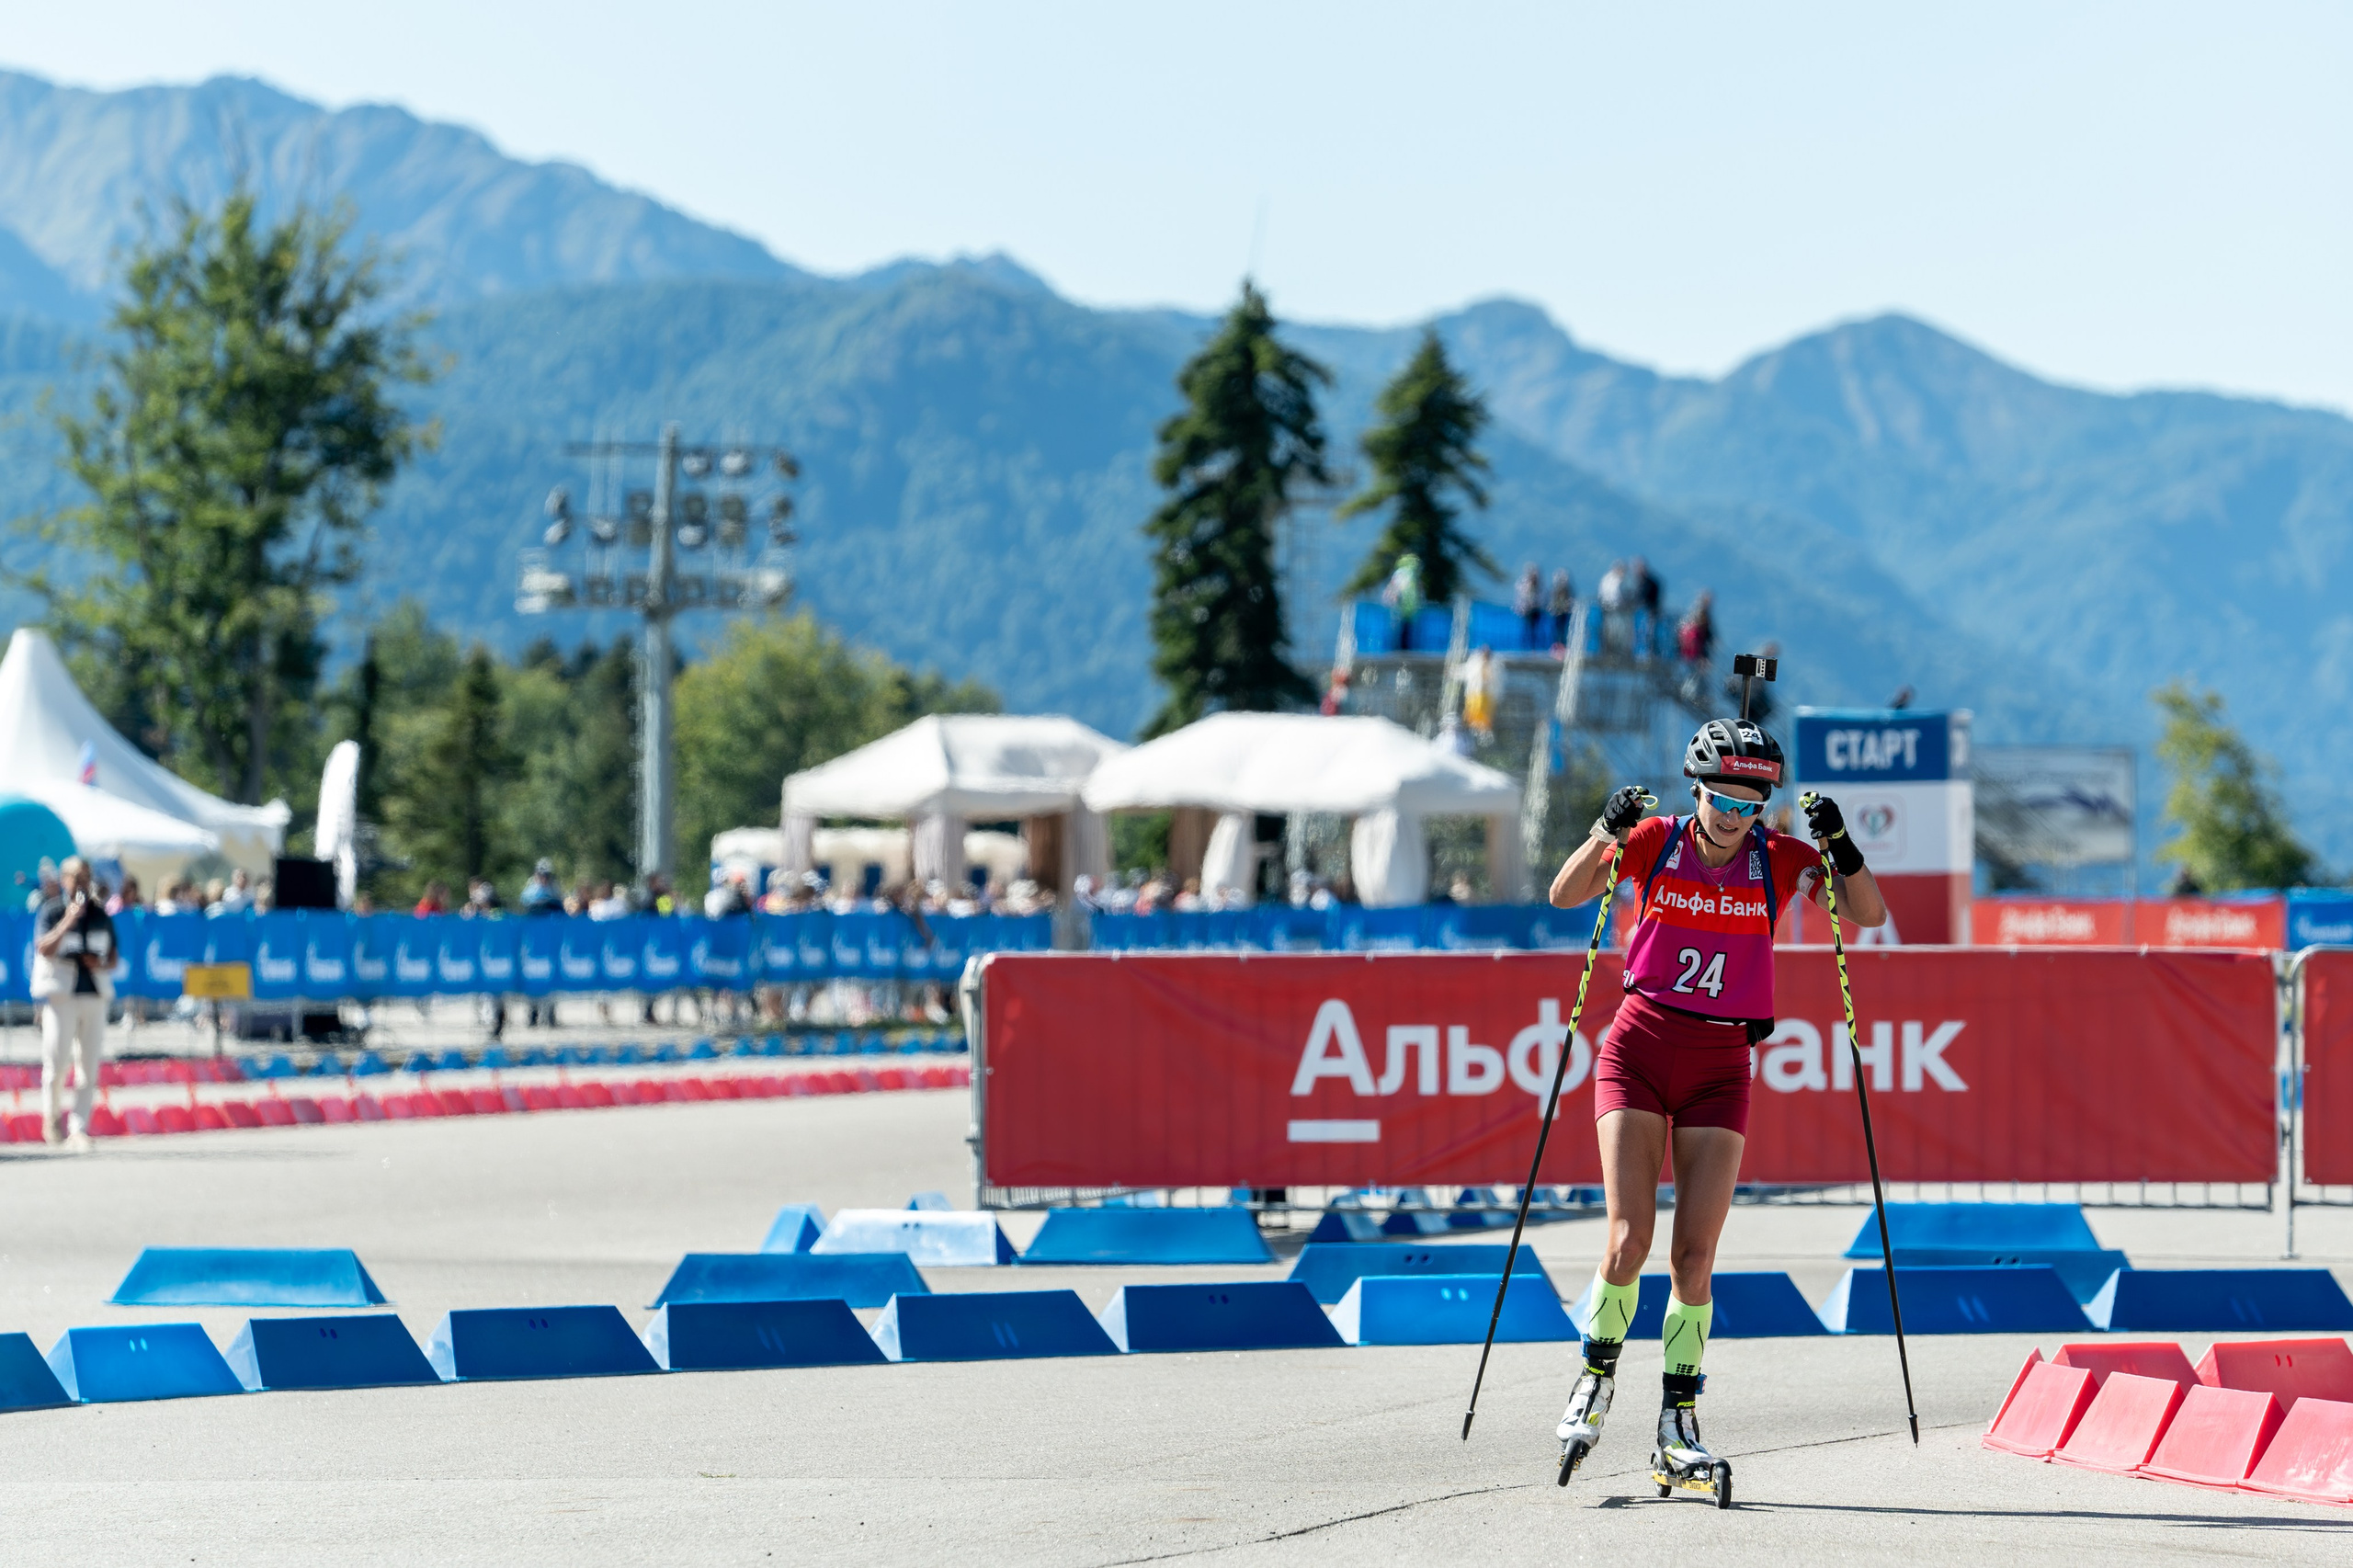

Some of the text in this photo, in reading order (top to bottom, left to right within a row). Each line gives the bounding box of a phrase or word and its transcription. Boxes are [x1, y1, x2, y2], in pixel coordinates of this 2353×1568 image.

[1742, 732, 1760, 741] 24
[1825, 728, 1921, 771] СТАРТ
[1733, 761, 1773, 772] Альфа Банк
[1654, 885, 1768, 917] Альфа Банк
[1671, 947, 1727, 999] 24
[1290, 998, 1610, 1120] Альф
